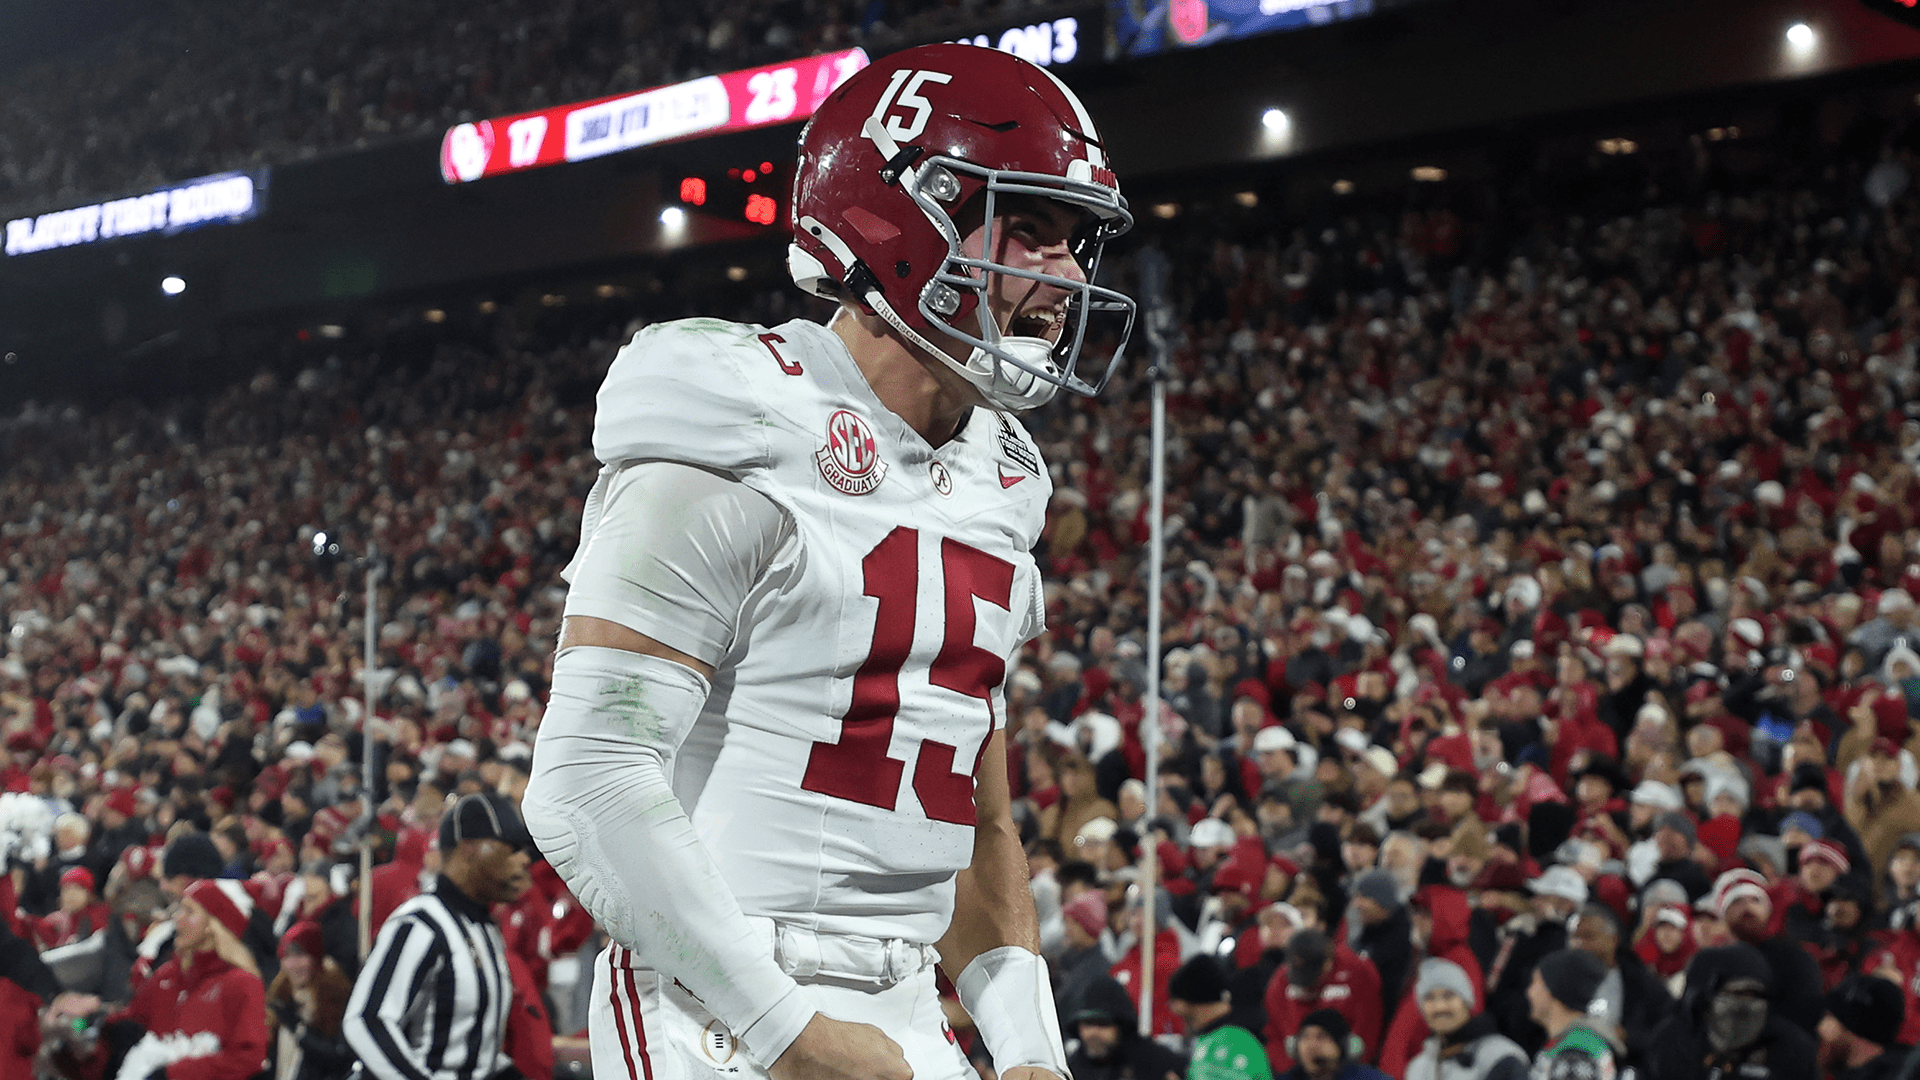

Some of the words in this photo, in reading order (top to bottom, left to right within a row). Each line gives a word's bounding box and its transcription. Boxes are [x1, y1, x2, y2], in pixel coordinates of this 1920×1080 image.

[1052, 16, 1078, 64] 3
[507, 116, 548, 167] 17
[745, 67, 798, 124] 23
[860, 69, 953, 143] 15
[99, 190, 169, 239] FIRST
[875, 299, 922, 344] CRIMSON
[757, 332, 804, 376] C
[830, 411, 876, 473] SEC
[823, 462, 881, 493] GRADUATE
[800, 525, 1016, 827] 15
